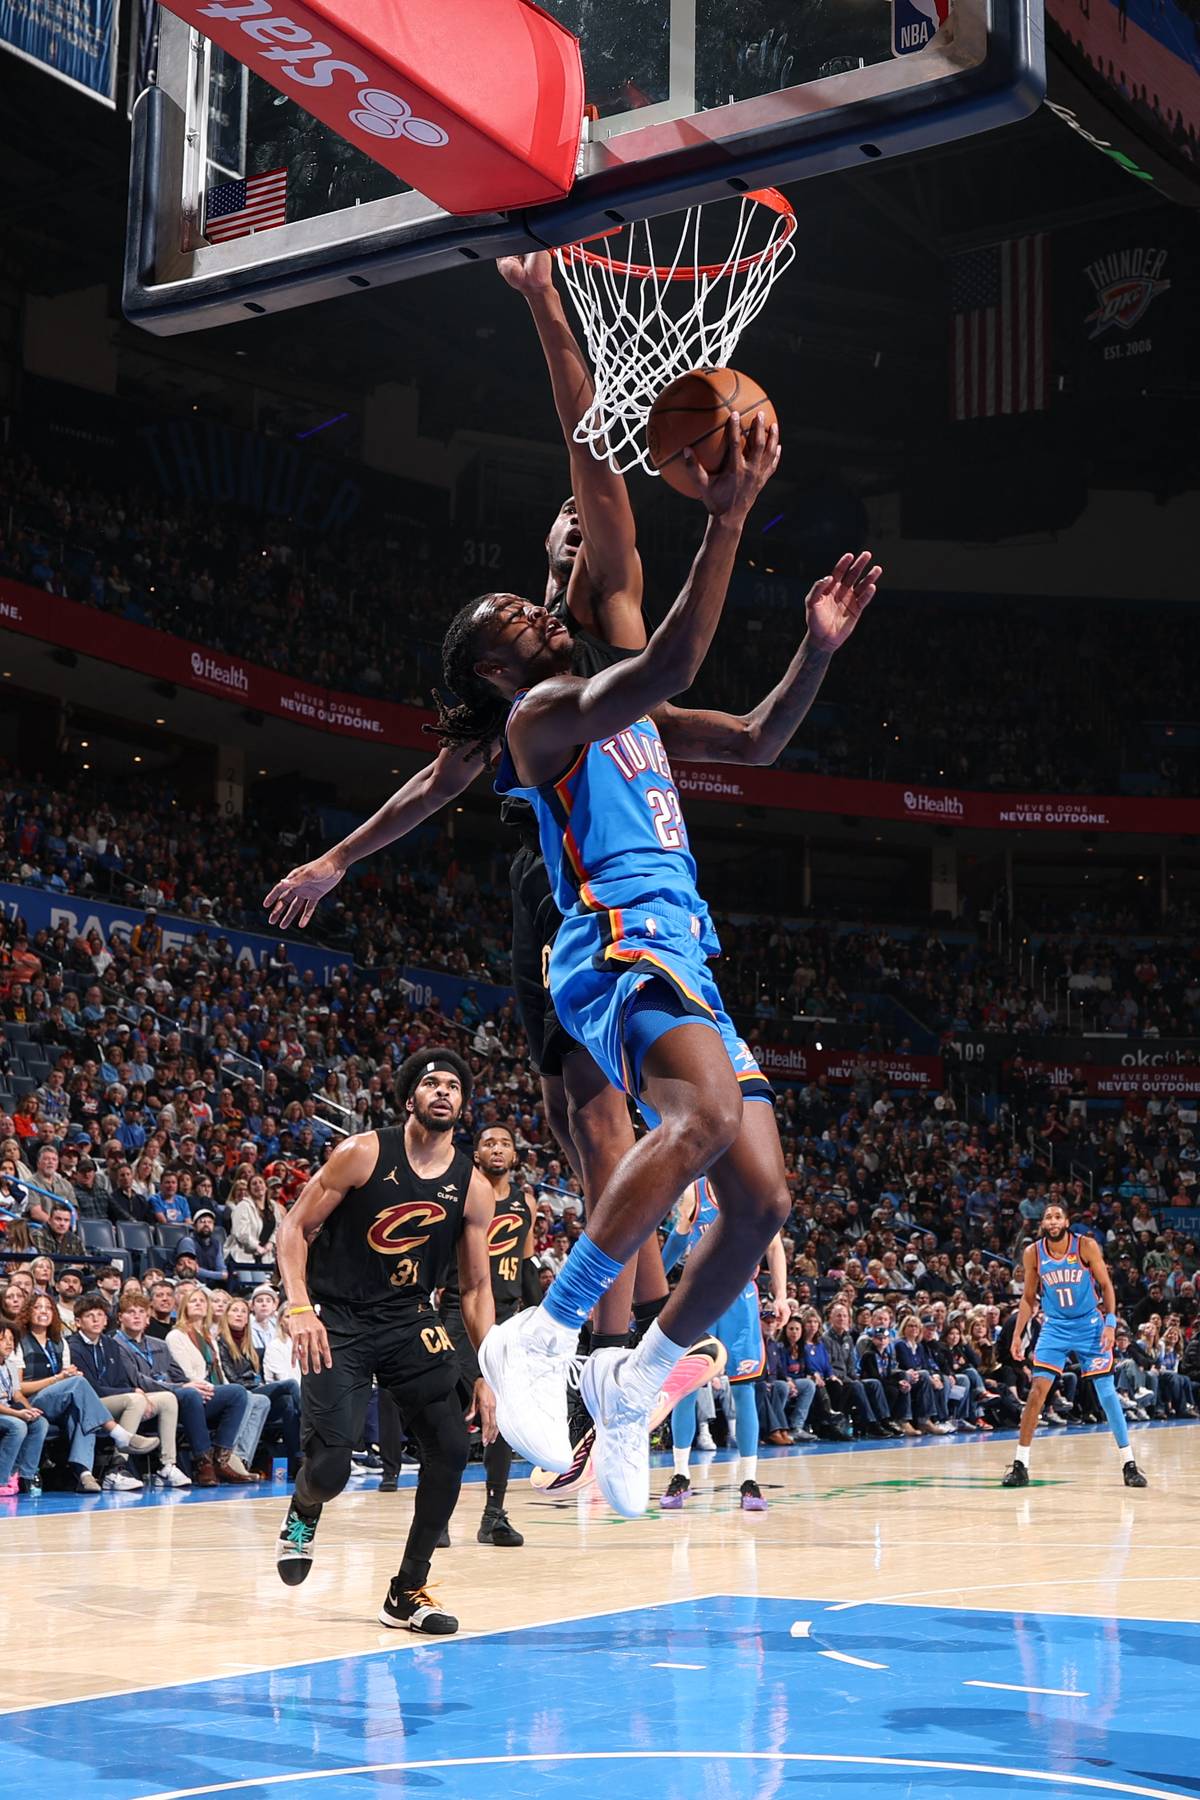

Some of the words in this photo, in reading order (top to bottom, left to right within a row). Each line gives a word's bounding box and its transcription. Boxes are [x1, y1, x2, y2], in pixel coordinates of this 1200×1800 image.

[195, 0, 369, 87] Stat
[901, 21, 929, 49] NBA
[1082, 247, 1168, 291] THUNDER
[1103, 343, 1125, 361] EST.
[464, 539, 502, 568] 312
[204, 658, 249, 692] Health
[294, 690, 325, 707] NEVER
[280, 695, 316, 718] NEVER
[317, 708, 384, 734] OUTDONE.
[679, 779, 744, 796] OUTDONE.
[917, 793, 965, 816] Health
[1015, 803, 1053, 813] NEVER
[1057, 804, 1092, 814] DONE.
[999, 811, 1042, 822] NEVER
[1045, 812, 1110, 824] OUTDONE.
[765, 1048, 807, 1070] Health
[1097, 1080, 1138, 1092] NEVER
[1112, 1072, 1149, 1082] NEVER
[437, 1191, 459, 1203] CLIFFS
[389, 1257, 420, 1287] 31
[498, 1256, 520, 1281] 45
[1041, 1268, 1084, 1286] THUNDER
[1056, 1287, 1074, 1308] 11
